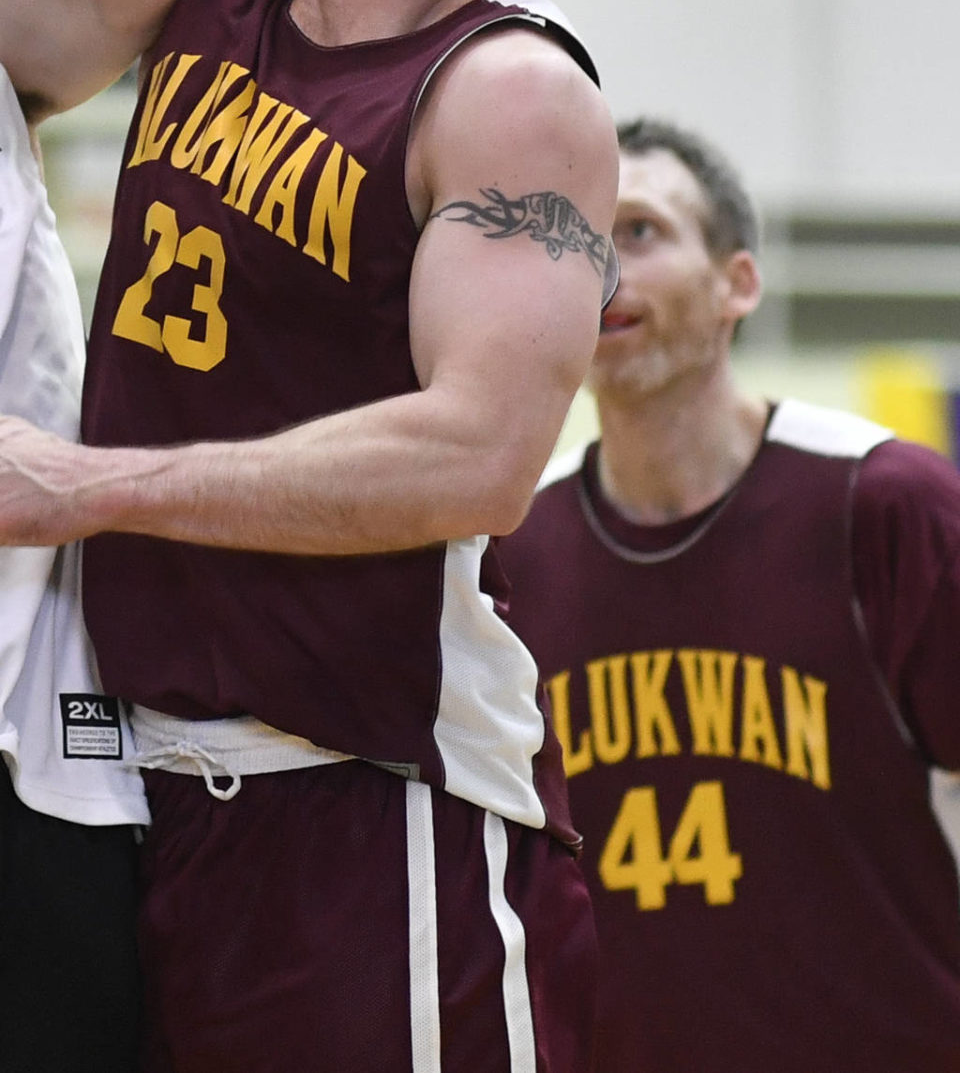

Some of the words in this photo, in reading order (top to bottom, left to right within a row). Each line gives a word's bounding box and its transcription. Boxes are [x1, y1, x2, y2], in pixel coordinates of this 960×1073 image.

[111, 200, 228, 373] 23
[67, 700, 113, 721] 2XL
[548, 647, 832, 791] LUKWAN
[598, 779, 744, 911] 44
